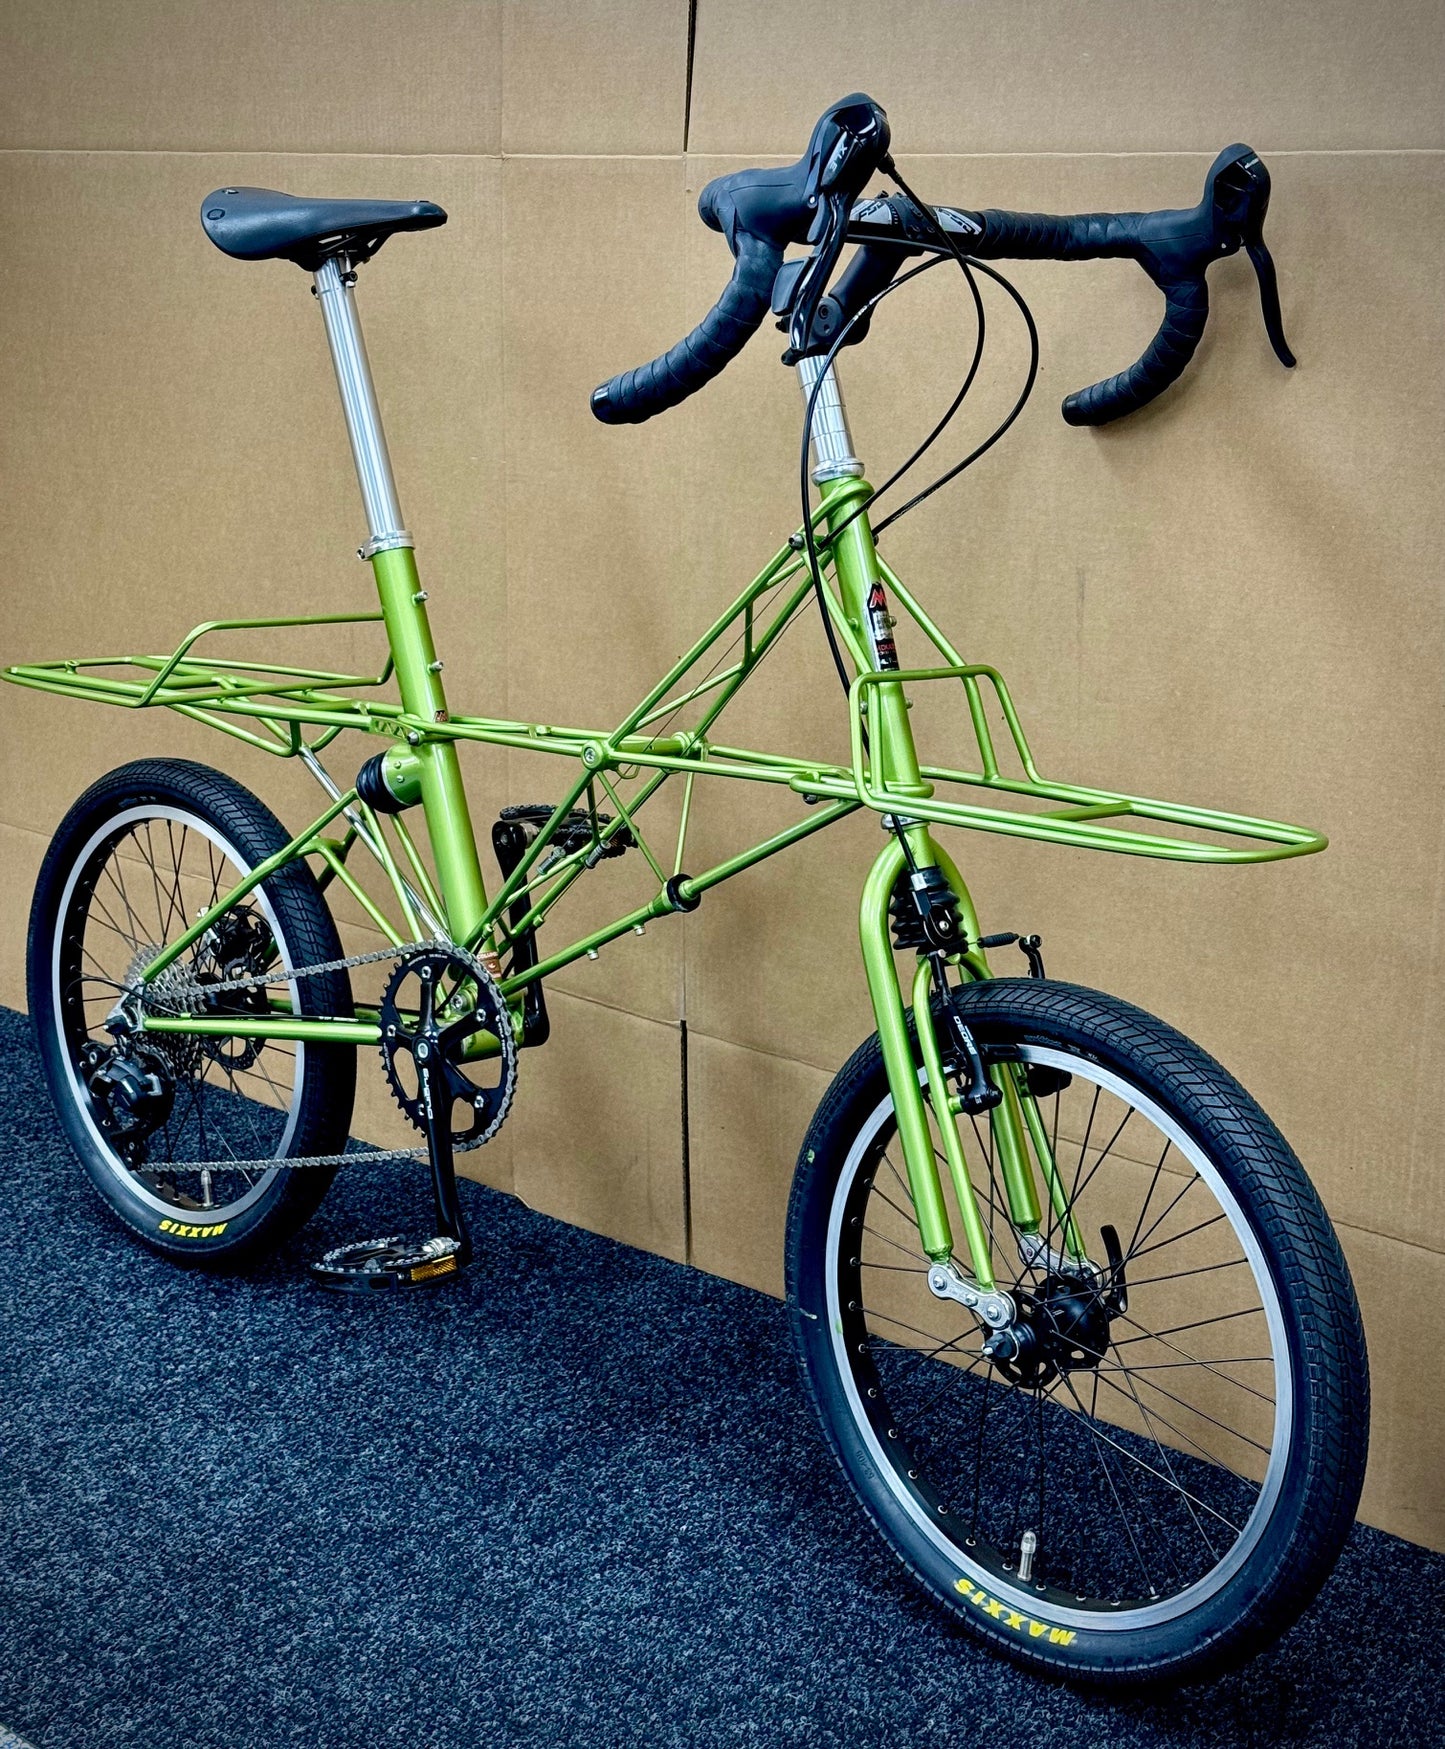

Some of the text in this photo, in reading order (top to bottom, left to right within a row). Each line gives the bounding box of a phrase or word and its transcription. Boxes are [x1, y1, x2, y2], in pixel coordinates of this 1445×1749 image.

[953, 1015, 978, 1055] DEORE
[158, 1219, 229, 1238] MAXXIS
[953, 1578, 1077, 1647] MAXXIS
